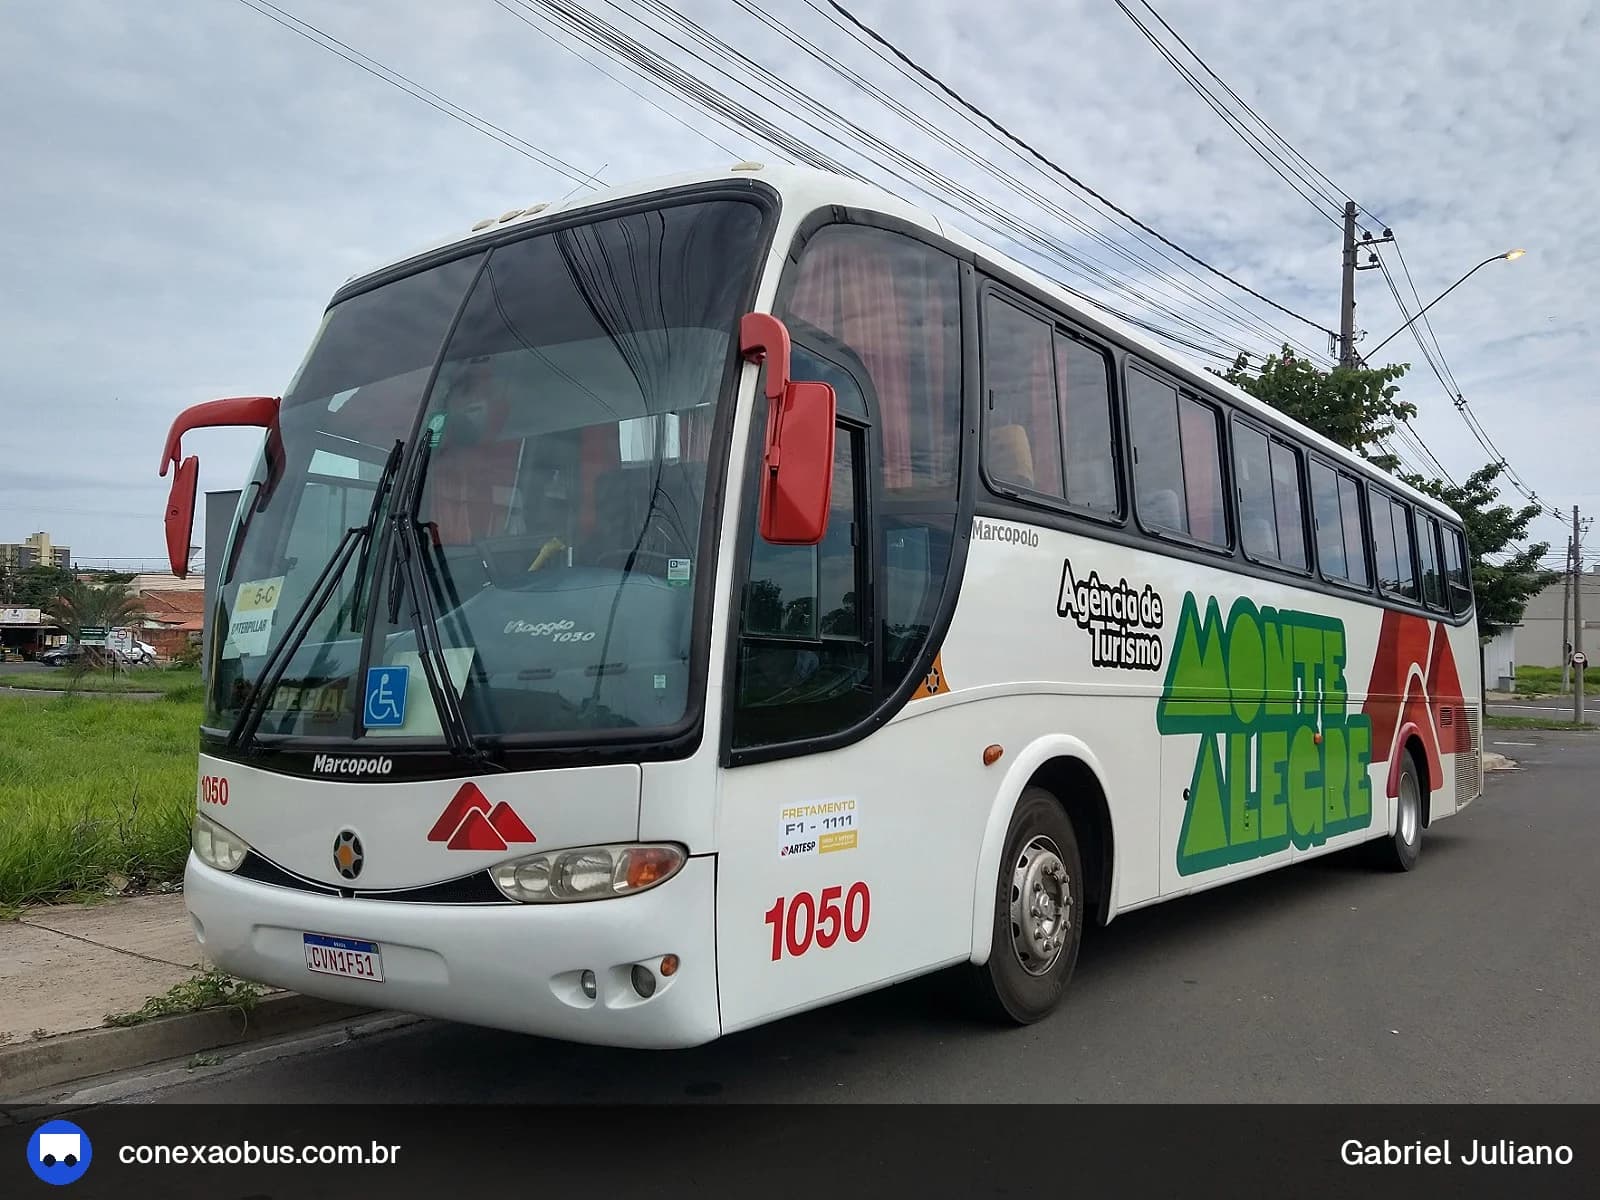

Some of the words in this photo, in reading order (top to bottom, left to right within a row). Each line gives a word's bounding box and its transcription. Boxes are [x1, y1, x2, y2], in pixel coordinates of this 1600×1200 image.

[972, 519, 1039, 548] Marcopolo
[254, 586, 275, 606] 5-C
[1057, 558, 1138, 630] Agência
[1140, 584, 1163, 629] de
[504, 618, 575, 636] Viaggio
[552, 631, 596, 642] 1050
[1088, 617, 1162, 671] Turismo
[1157, 591, 1347, 735] MONTE
[313, 755, 392, 775] Marcopolo
[202, 776, 229, 806] 1050
[1176, 714, 1372, 877] ALEGRE
[782, 800, 855, 820] FRETAMENTO
[785, 821, 804, 835] F1
[823, 815, 852, 829] 1111
[788, 841, 816, 855] ARTESP
[765, 881, 871, 962] 1050
[312, 947, 374, 976] CVN1F51
